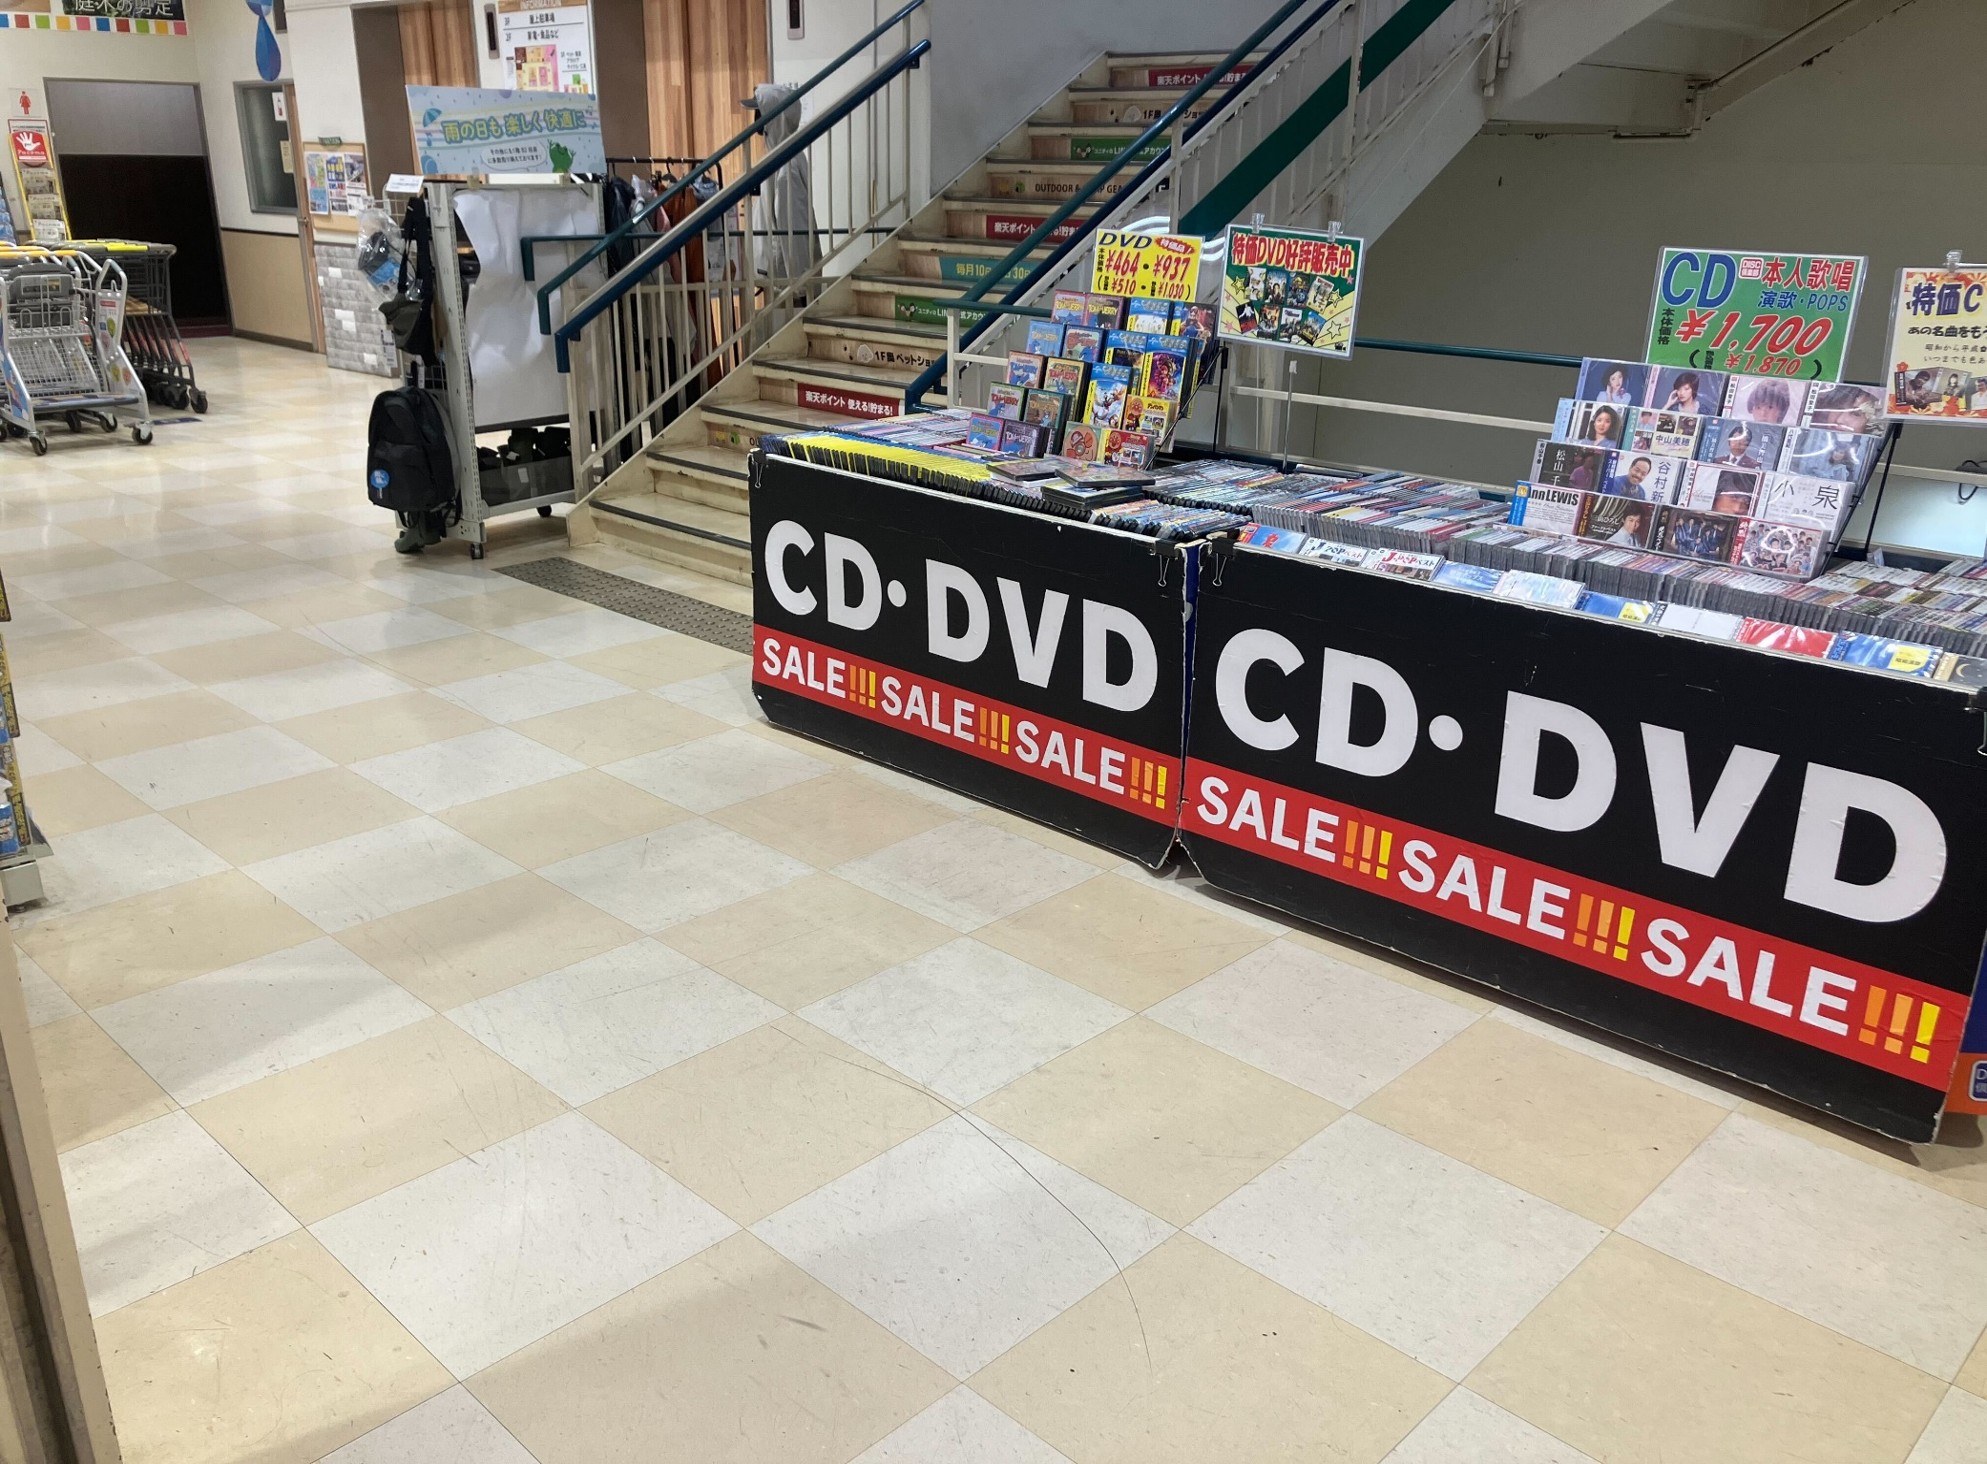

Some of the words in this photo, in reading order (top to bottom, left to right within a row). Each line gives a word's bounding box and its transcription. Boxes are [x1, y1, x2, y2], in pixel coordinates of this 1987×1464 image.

[1035, 183, 1074, 193] OUTDOOR
[1099, 232, 1153, 249] DVD
[1232, 232, 1354, 277] 特価DVD好評販売中
[1105, 249, 1141, 278] ¥464
[1153, 254, 1191, 282] ¥937
[1661, 252, 1737, 309] CD
[1742, 259, 1762, 269] DISC
[1762, 256, 1856, 292] 本人歌唱
[1111, 277, 1137, 295] ¥510
[1657, 307, 1675, 346] 本体価格
[1675, 309, 1834, 356] ¥1,700
[1655, 434, 1691, 447] 中山美穂
[1651, 461, 1672, 502] 谷村新
